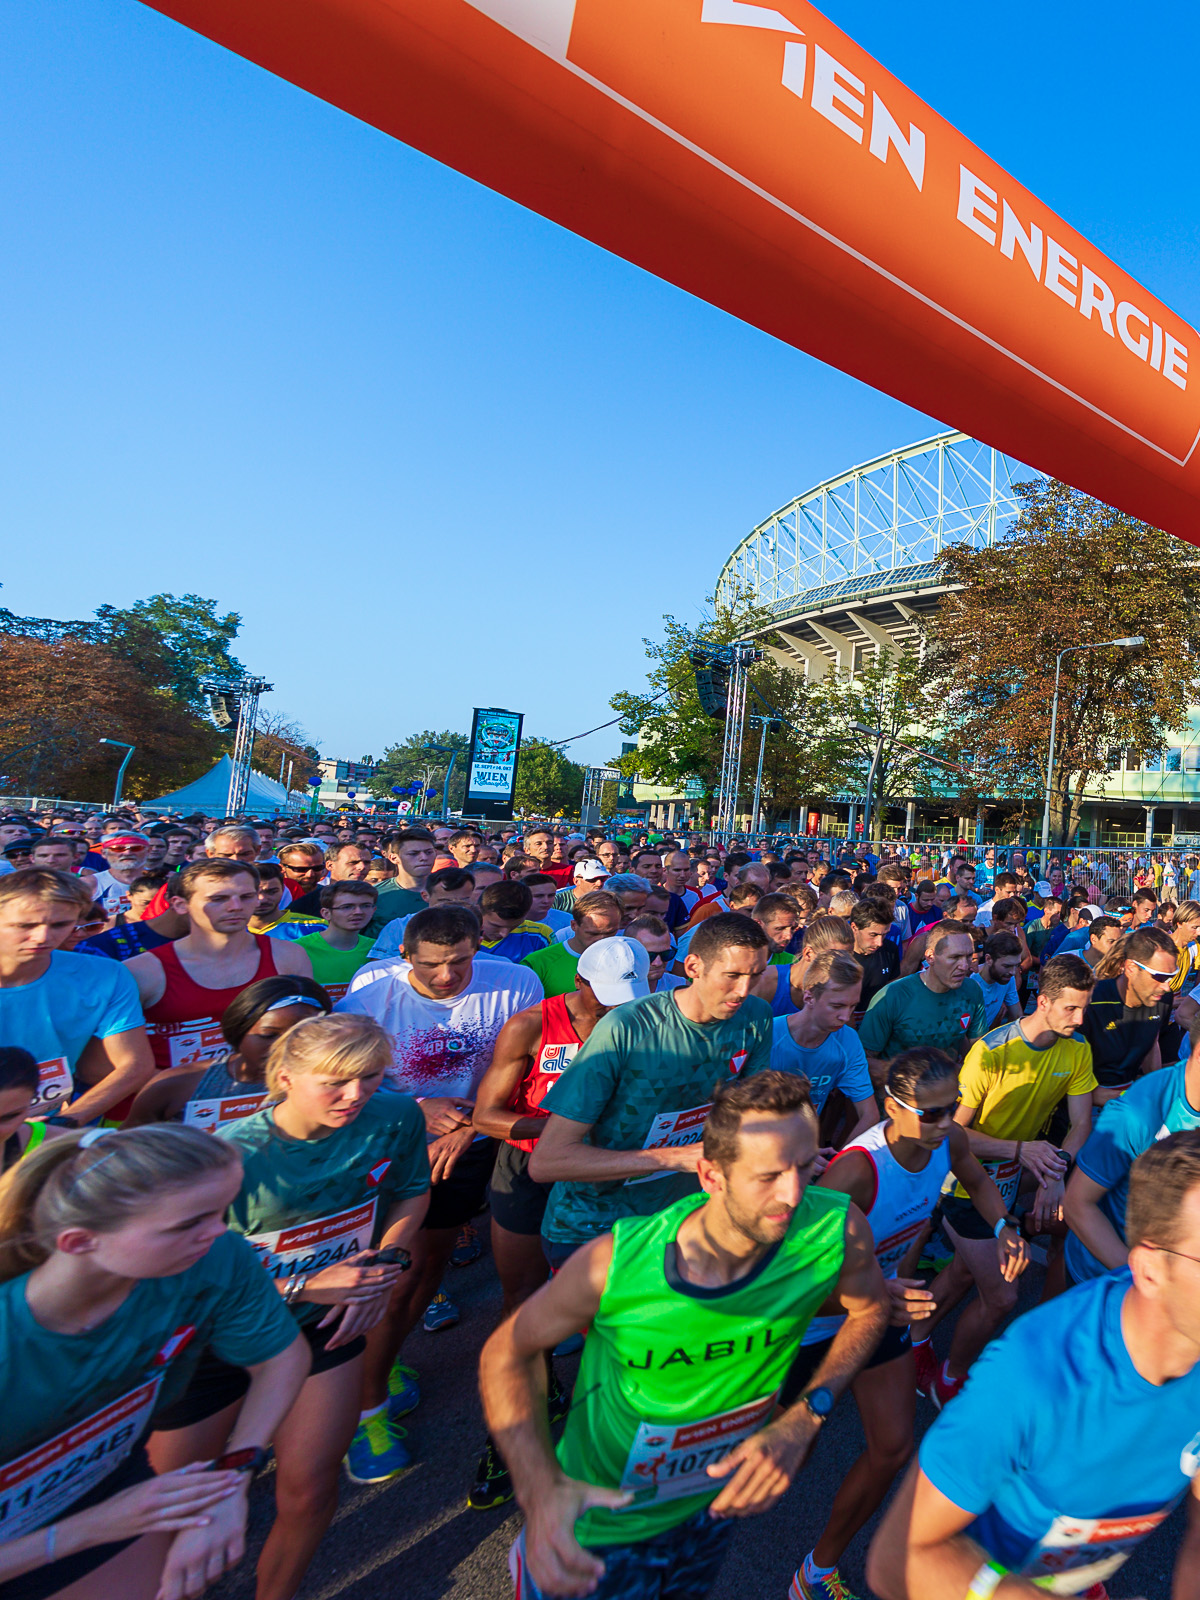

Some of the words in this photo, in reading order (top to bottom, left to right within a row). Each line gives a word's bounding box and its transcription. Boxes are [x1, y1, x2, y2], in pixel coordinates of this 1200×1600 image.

[956, 163, 1190, 391] ENERGIE
[477, 771, 508, 781] WIEN
[223, 1102, 258, 1114] WIEN
[281, 1229, 320, 1246] WIEN
[322, 1209, 371, 1235] ENERGIE
[269, 1237, 361, 1280] 11224A
[628, 1329, 792, 1370] JABIL
[679, 1423, 719, 1441] WIEN
